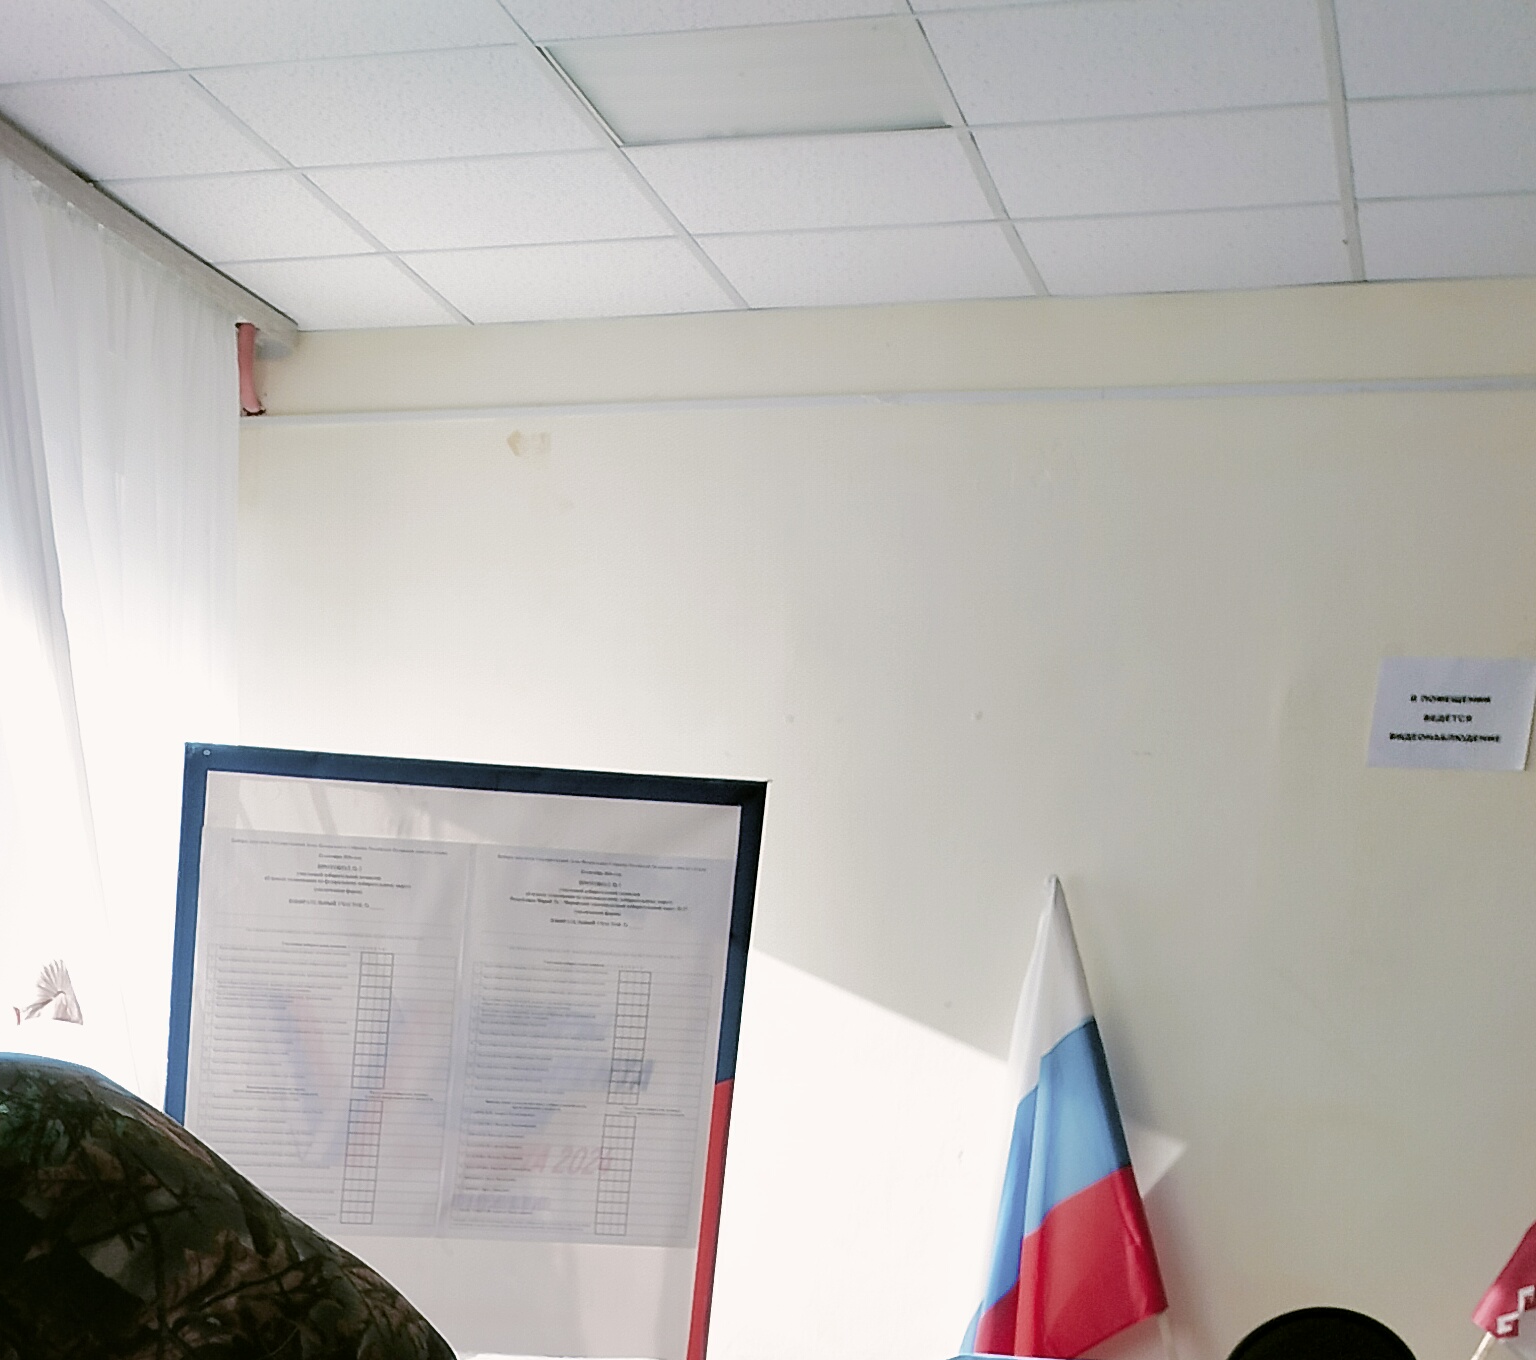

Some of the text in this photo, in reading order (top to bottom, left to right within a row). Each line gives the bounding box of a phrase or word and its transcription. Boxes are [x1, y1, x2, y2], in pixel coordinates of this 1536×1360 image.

[1410, 694, 1417, 702] В
[1423, 714, 1472, 723] ВЕДЕТСЯ
[1389, 732, 1501, 743] ВИДЕОНАБЛЮДЕНИЕ
